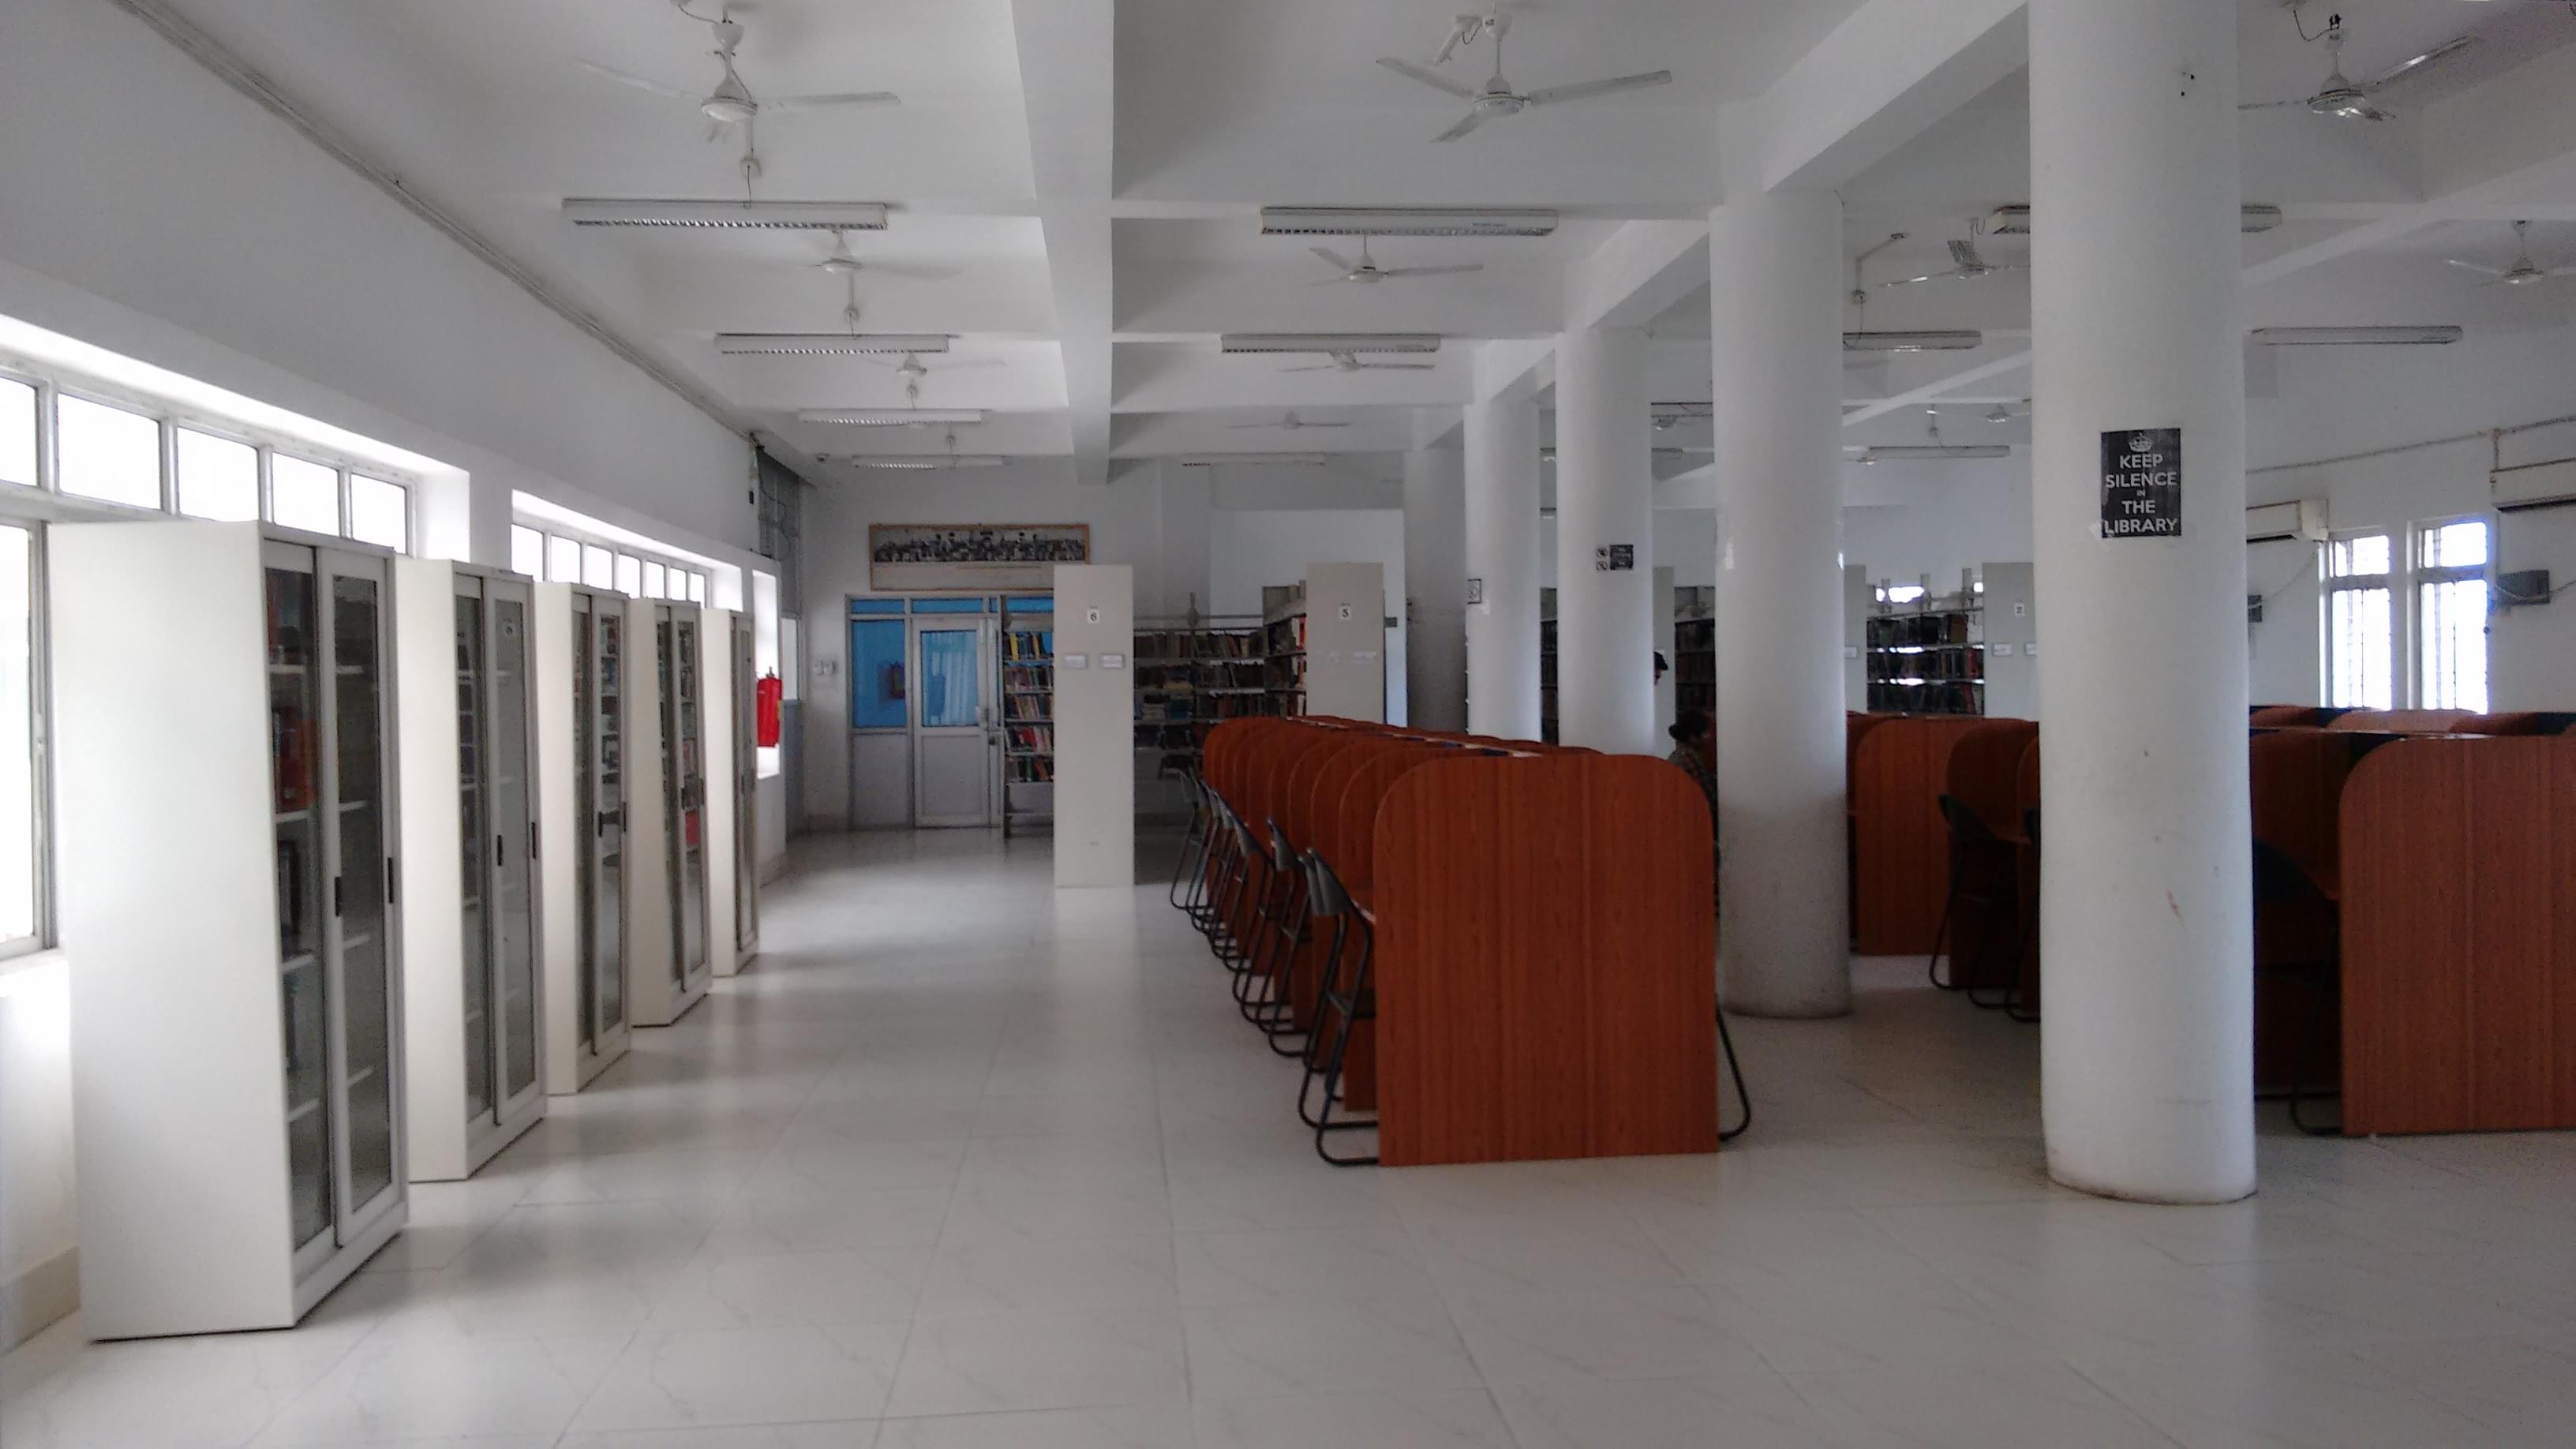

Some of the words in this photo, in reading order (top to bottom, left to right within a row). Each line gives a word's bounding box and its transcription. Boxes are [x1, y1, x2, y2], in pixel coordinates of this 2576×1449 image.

[2120, 454, 2163, 469] KEEP
[2106, 472, 2177, 488] SILENCE
[2121, 500, 2155, 515] THE
[2104, 518, 2177, 534] LIBRARY
